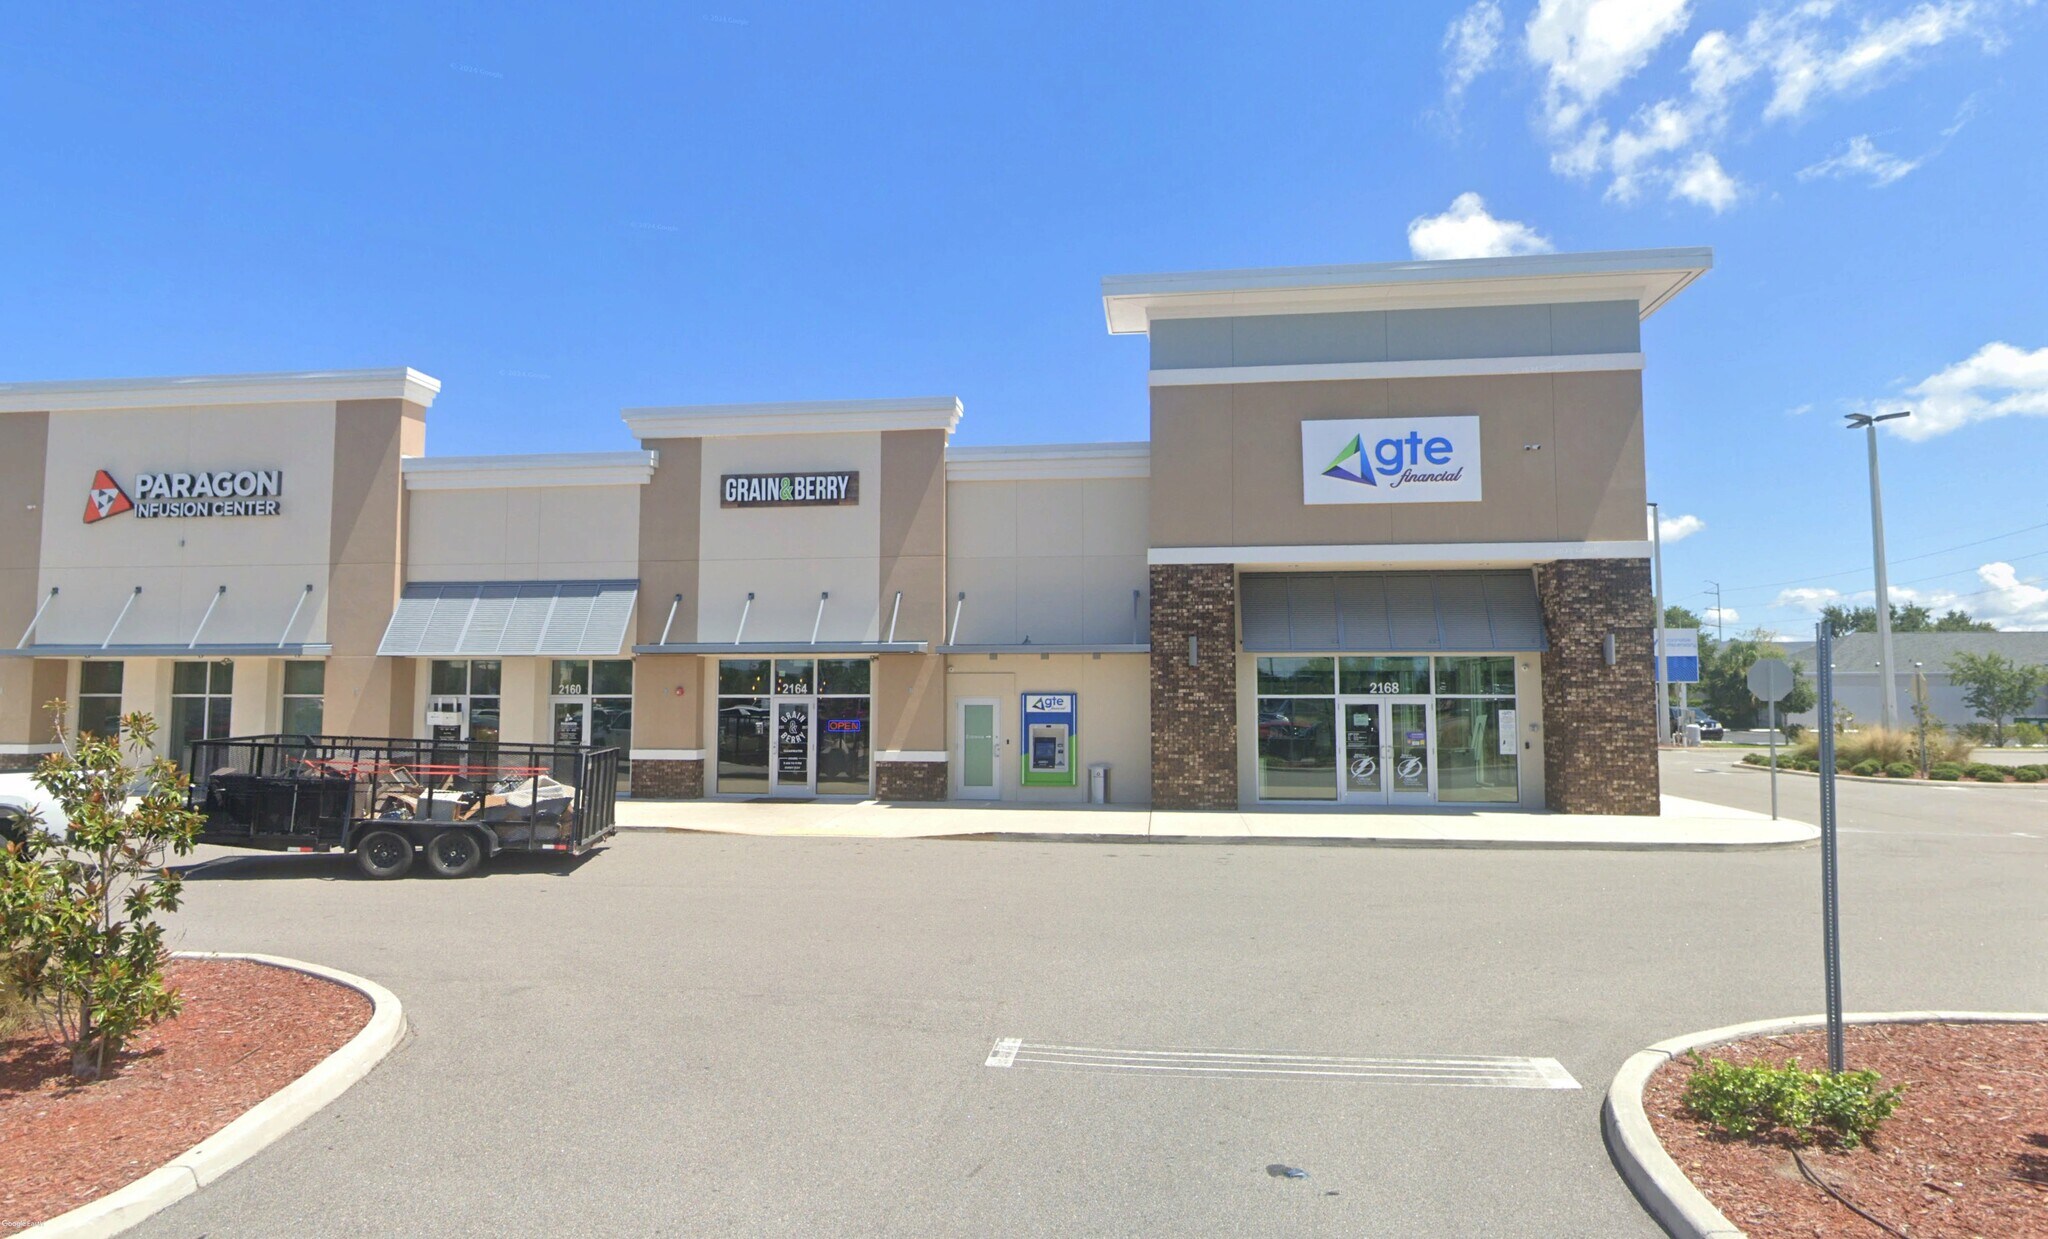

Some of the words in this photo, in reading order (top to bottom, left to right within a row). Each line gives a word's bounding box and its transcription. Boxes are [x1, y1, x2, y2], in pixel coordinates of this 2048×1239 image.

[1375, 431, 1454, 476] gte
[1390, 467, 1464, 488] financial
[135, 470, 281, 499] PARAGON
[134, 503, 208, 518] INFUSION
[212, 501, 281, 516] CENTER
[558, 684, 581, 695] 2160
[782, 683, 807, 694] 2164
[1369, 682, 1399, 694] 2168
[1044, 696, 1064, 708] gte
[780, 710, 806, 723] GRAIN
[830, 722, 859, 730] OPEN
[780, 731, 806, 744] BERRY
